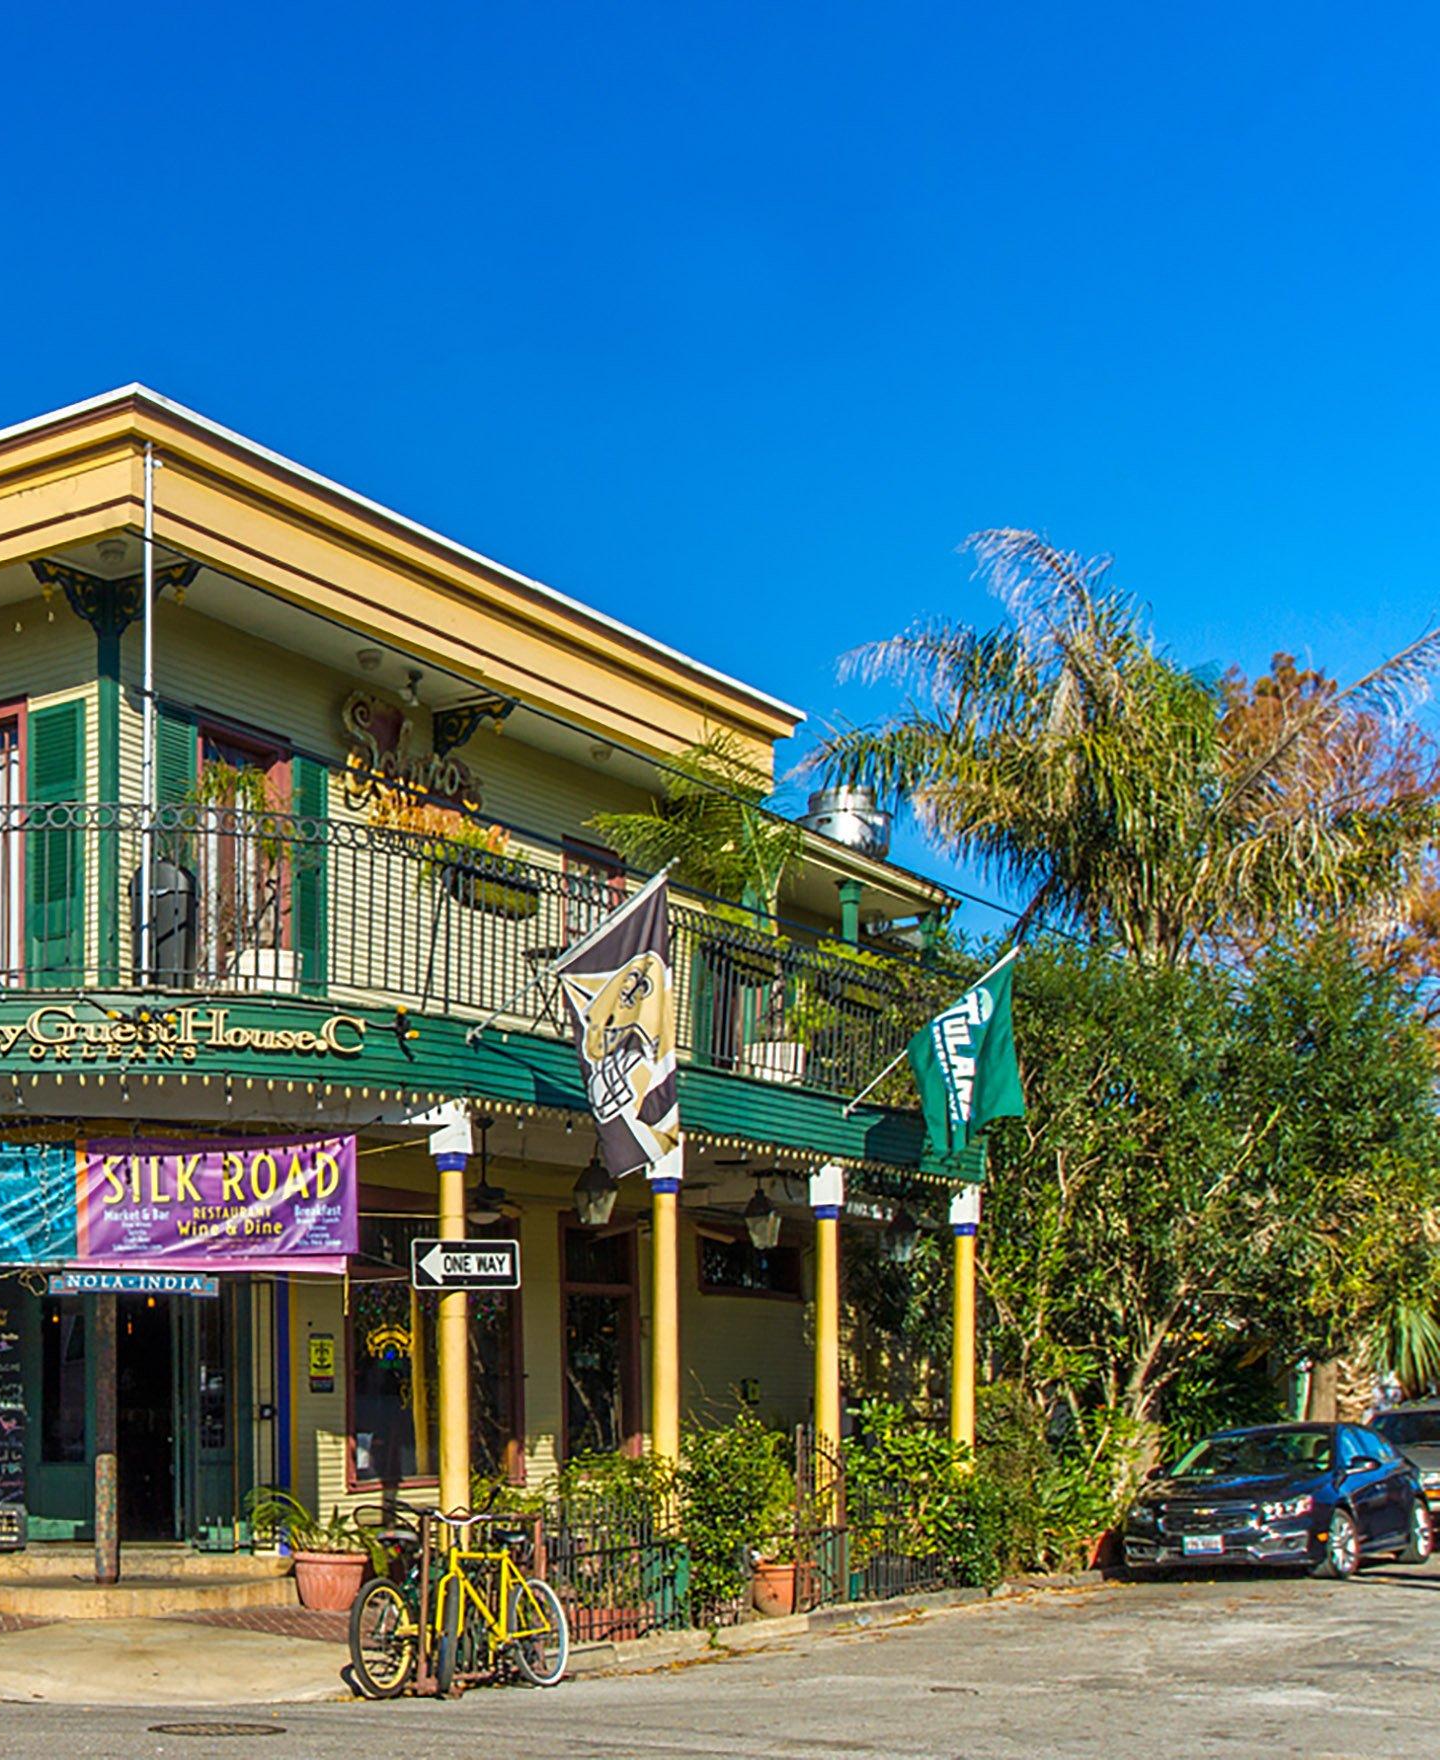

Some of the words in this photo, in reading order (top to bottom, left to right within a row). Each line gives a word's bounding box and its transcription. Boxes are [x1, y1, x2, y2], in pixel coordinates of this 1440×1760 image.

[28, 1045, 197, 1060] ORLEANS
[102, 1154, 203, 1205] SILK
[222, 1151, 340, 1202] ROAD
[193, 1205, 273, 1219] RESTAURANT
[294, 1203, 342, 1217] Breakfast
[176, 1219, 219, 1236] Wine
[225, 1219, 239, 1236] &
[244, 1218, 283, 1236] Dine
[443, 1254, 472, 1273] ONE
[475, 1255, 506, 1273] WAY
